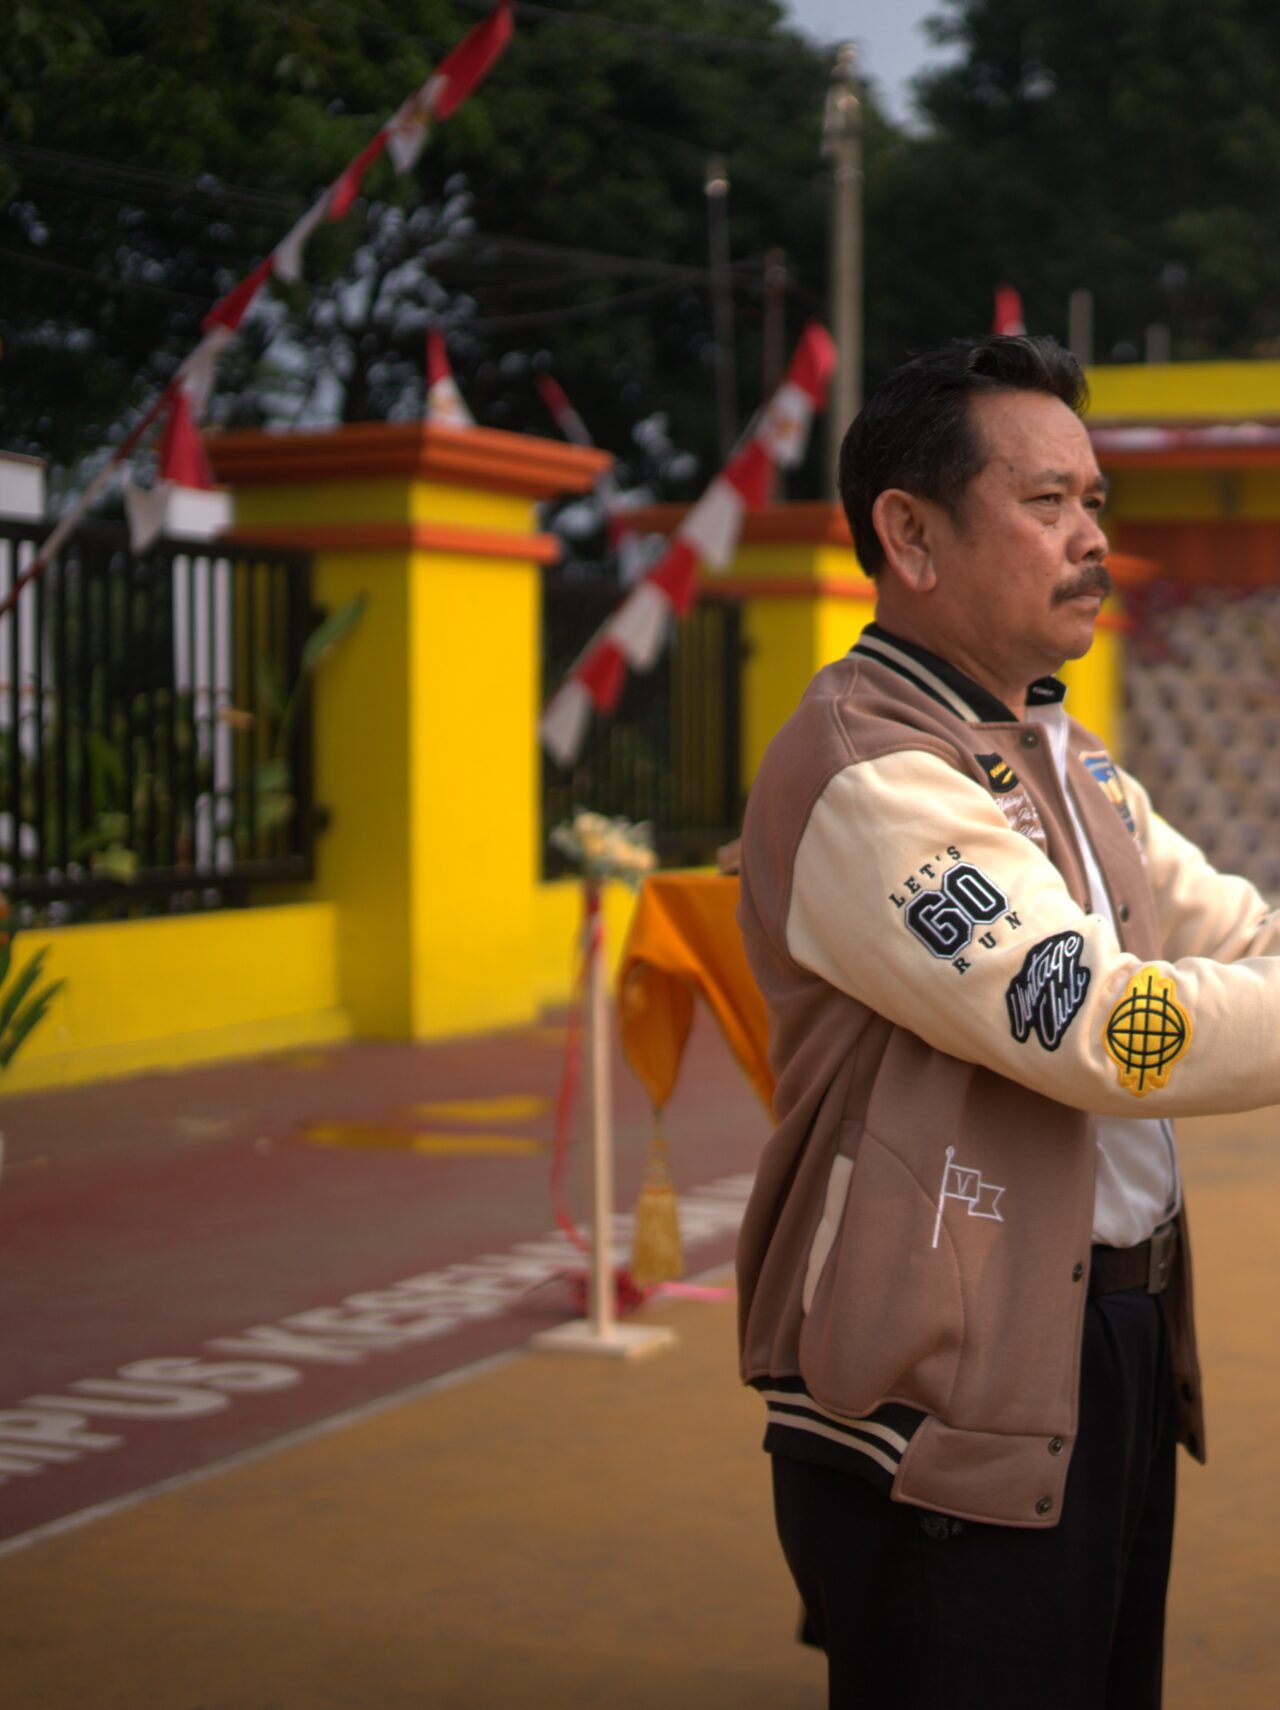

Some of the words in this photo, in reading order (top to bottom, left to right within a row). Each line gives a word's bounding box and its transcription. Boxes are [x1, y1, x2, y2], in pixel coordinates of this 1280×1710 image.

[888, 846, 961, 909] LET'S
[904, 861, 1009, 959] GO
[952, 911, 1022, 975] RUN
[956, 1171, 975, 1195] V
